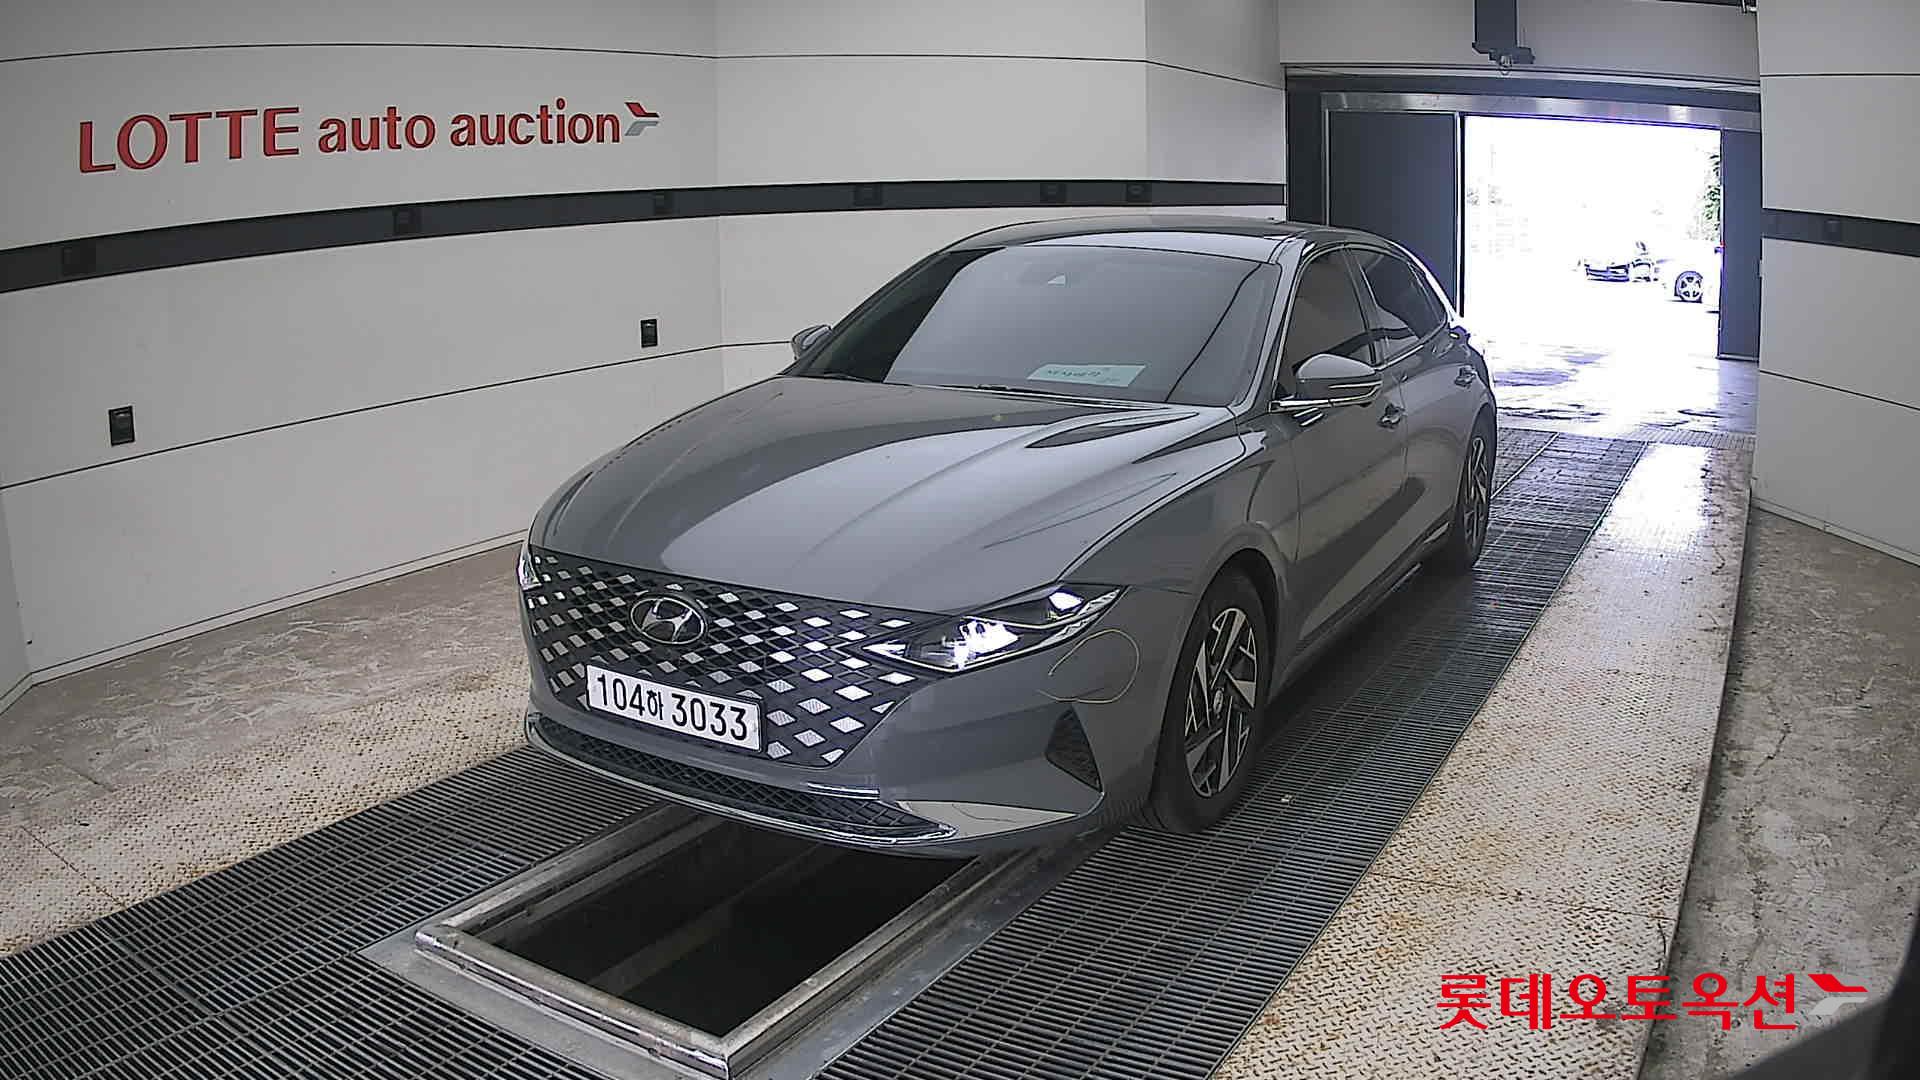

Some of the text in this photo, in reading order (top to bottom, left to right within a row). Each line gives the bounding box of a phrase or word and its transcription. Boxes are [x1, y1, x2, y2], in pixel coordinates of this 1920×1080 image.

[79, 97, 621, 173] LOTTE auto auction
[597, 674, 748, 741] 104하 3033
